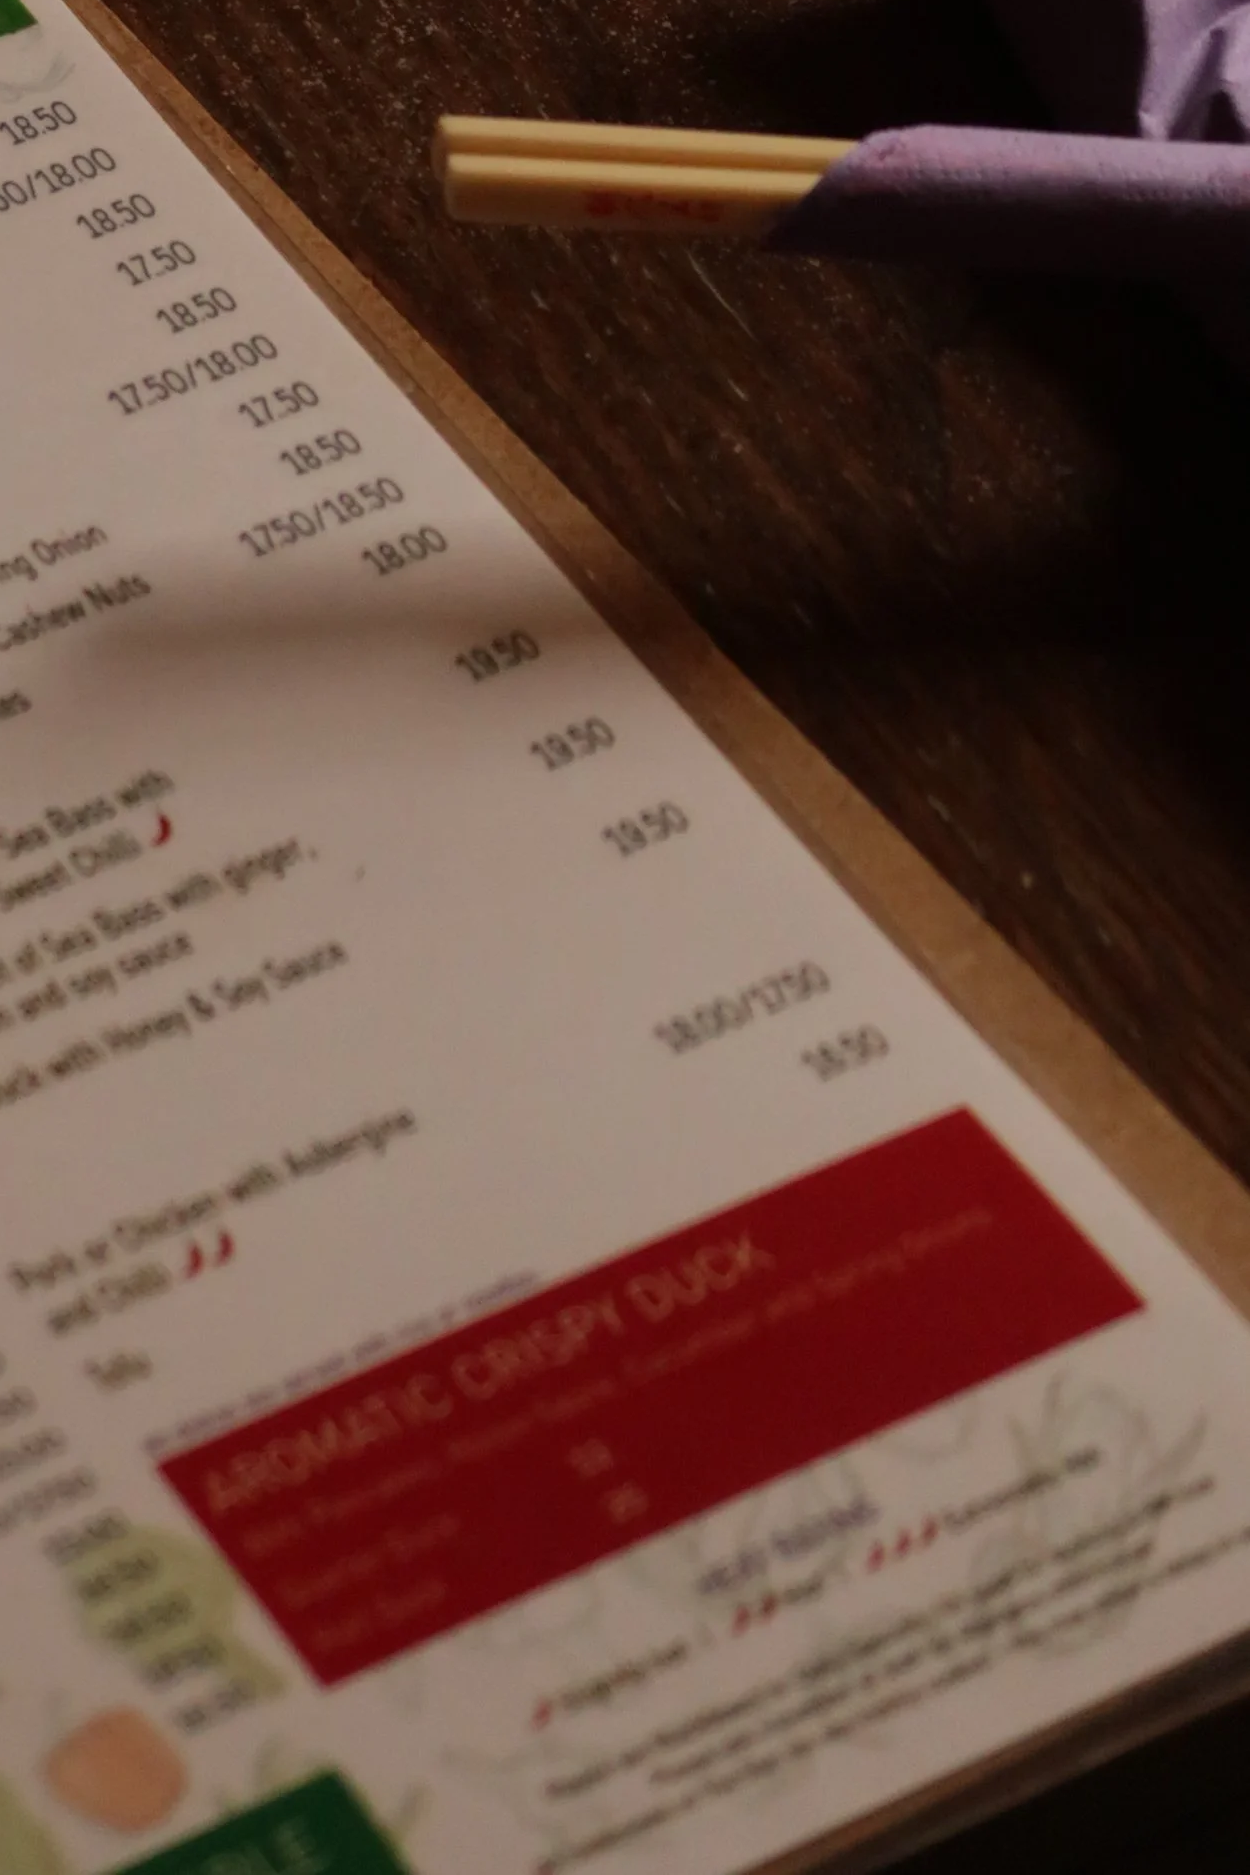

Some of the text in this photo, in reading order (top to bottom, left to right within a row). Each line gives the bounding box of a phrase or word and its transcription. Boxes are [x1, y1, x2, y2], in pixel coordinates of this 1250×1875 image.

[75, 193, 157, 240] 18.50
[115, 240, 197, 287] 17.50
[155, 287, 238, 334] 18.50
[106, 334, 279, 416] 17.50/18.00
[237, 380, 320, 429] 17.50
[278, 428, 363, 476] 18.50
[29, 525, 108, 566] Onion
[360, 525, 448, 577] 18.00
[454, 626, 541, 683] 19.50
